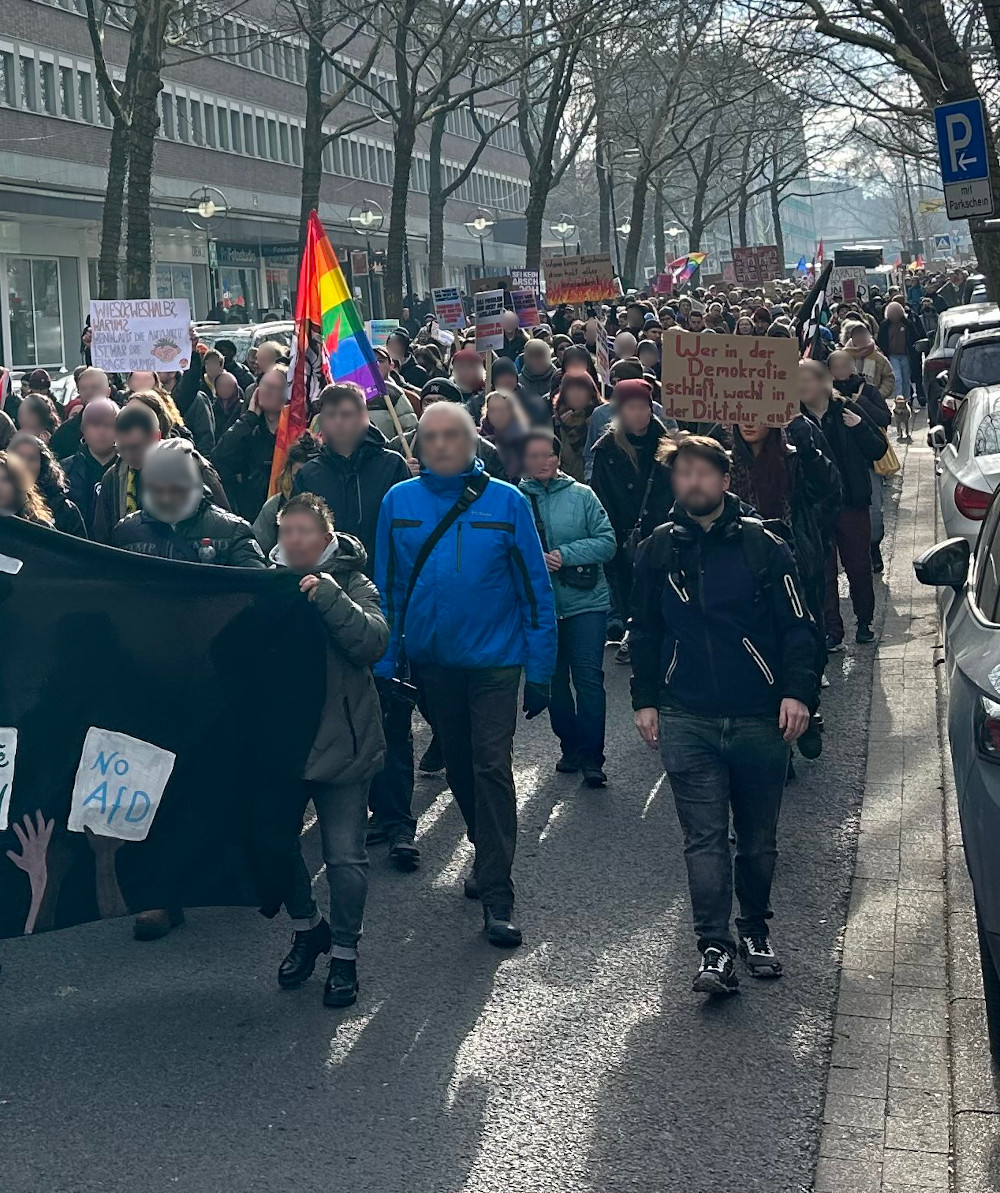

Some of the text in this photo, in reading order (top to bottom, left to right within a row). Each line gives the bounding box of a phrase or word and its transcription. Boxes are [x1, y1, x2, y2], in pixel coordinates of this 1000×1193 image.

[945, 113, 973, 173] P
[961, 184, 973, 195] mit
[949, 197, 989, 211] Parkschein
[675, 334, 775, 359] Wer in der
[687, 357, 787, 380] Demokratie
[723, 380, 764, 400] wacht
[772, 386, 785, 401] in
[665, 398, 794, 424] der Diktatur auf
[82, 780, 151, 825] AfD
